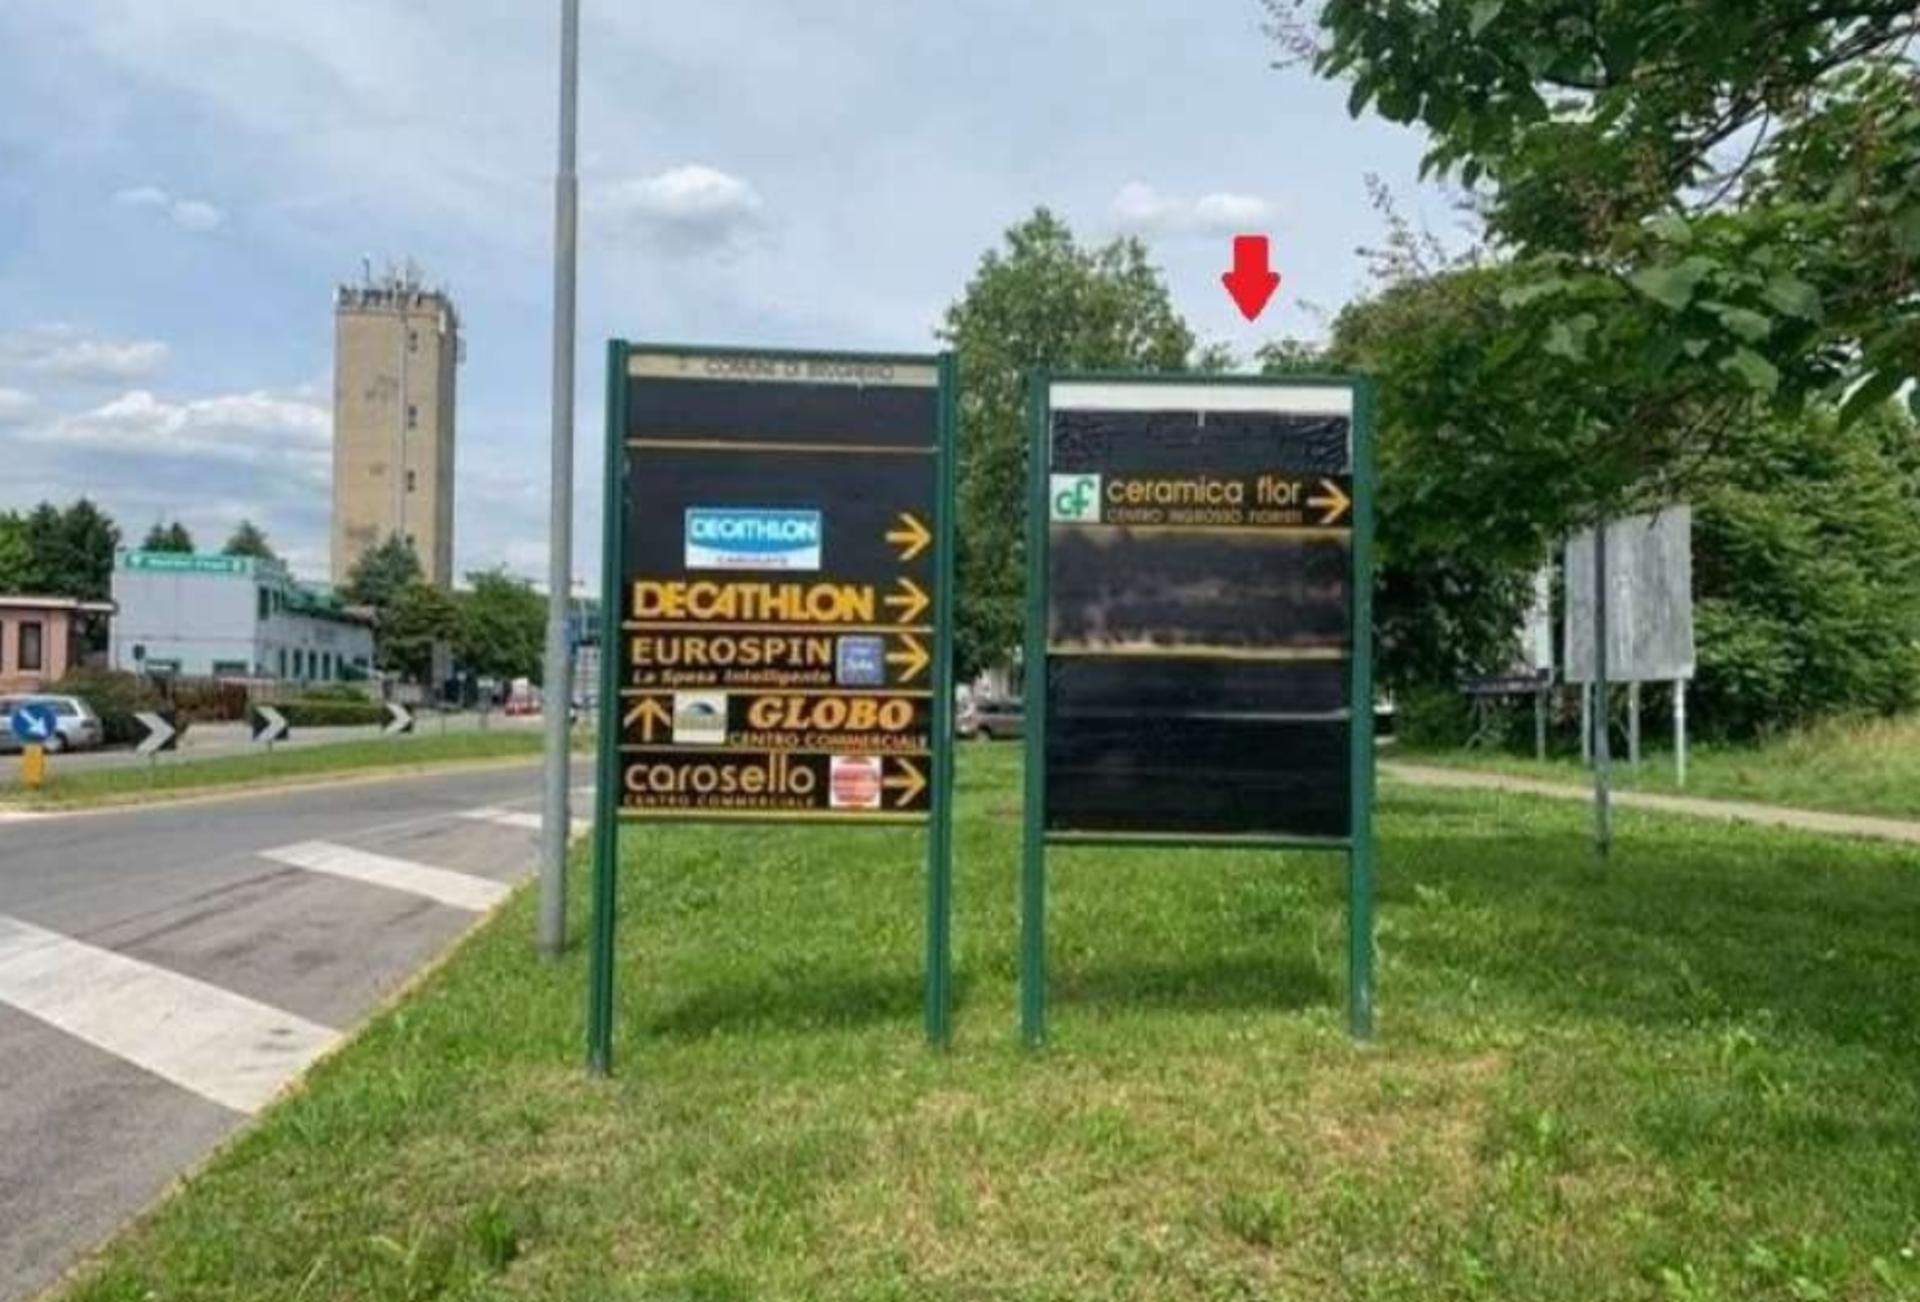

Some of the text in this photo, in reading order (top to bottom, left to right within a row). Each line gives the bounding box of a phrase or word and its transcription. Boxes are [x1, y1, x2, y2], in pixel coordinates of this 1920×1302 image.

[1106, 475, 1303, 504] ceramica flor
[691, 518, 817, 542] DECATHLON
[633, 581, 875, 621] DECATHLON
[631, 637, 831, 666] EUROSPIN
[748, 696, 915, 731] GLOBO
[729, 733, 800, 748] CENTRO
[624, 751, 816, 794] carosello
